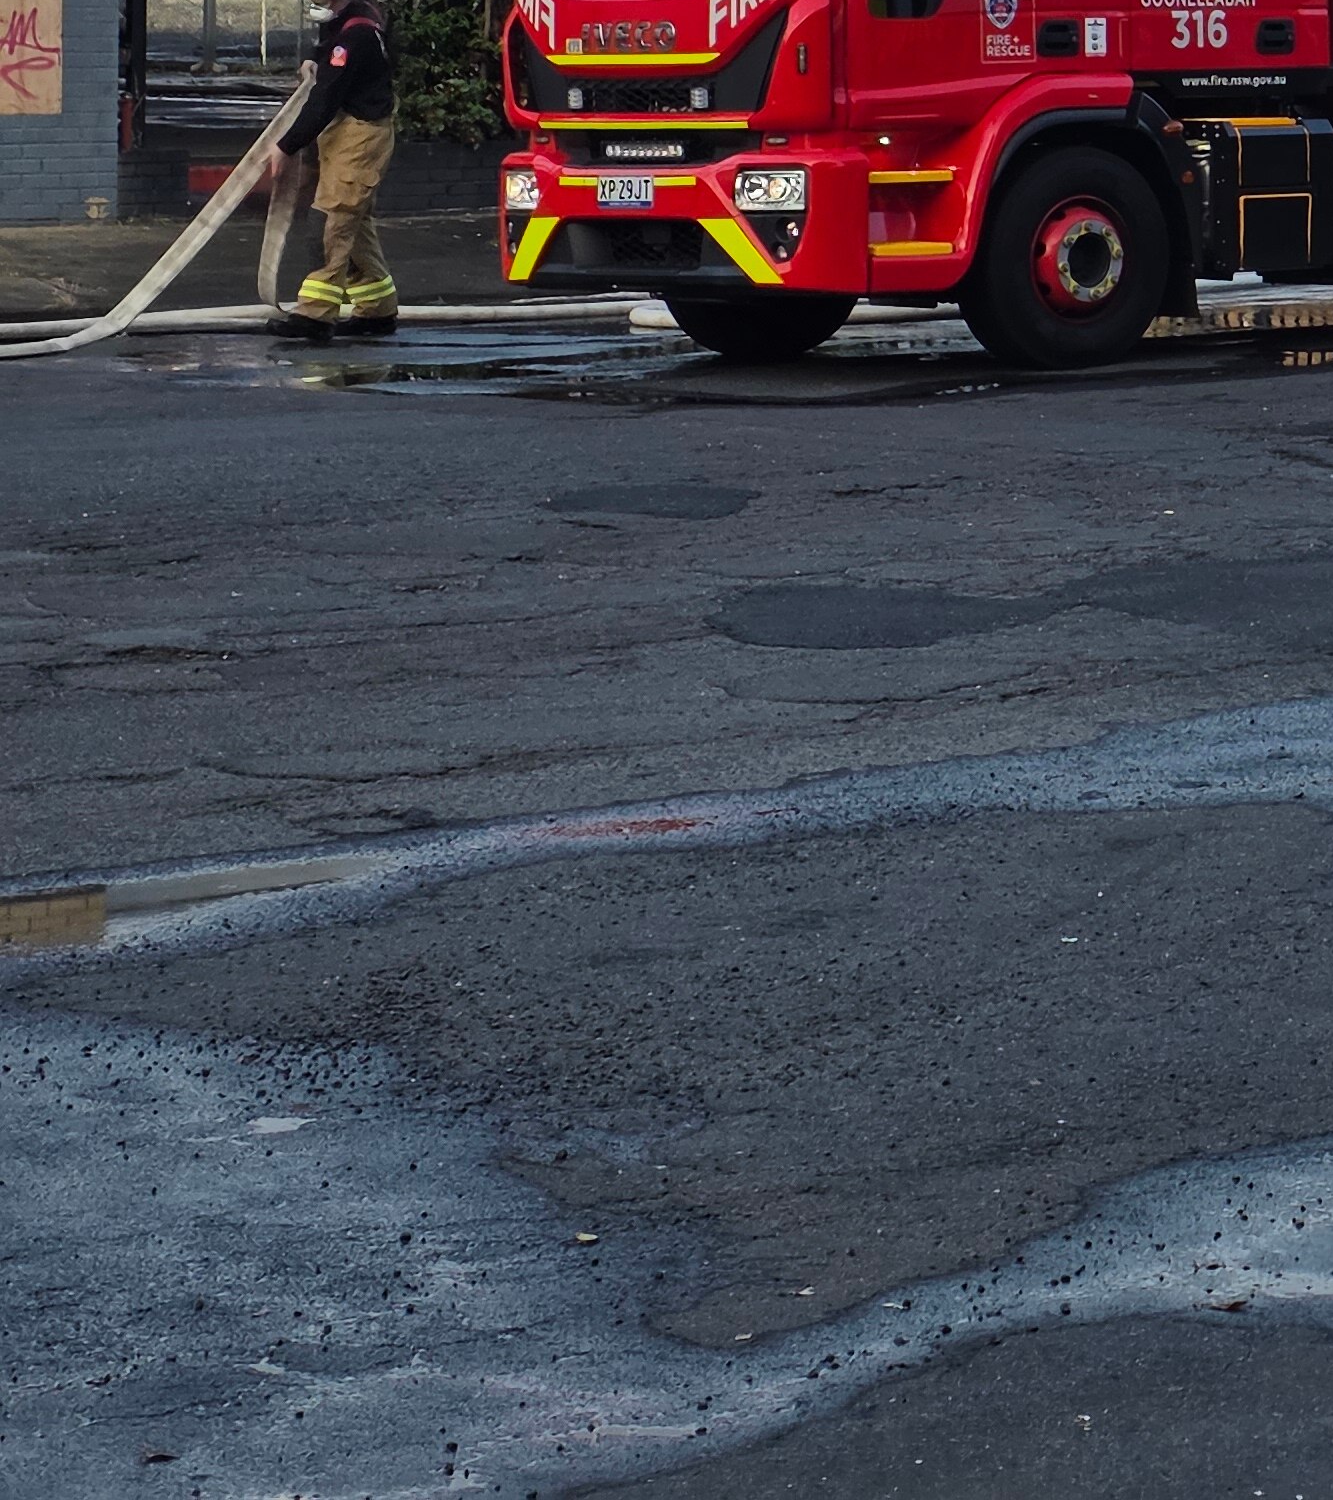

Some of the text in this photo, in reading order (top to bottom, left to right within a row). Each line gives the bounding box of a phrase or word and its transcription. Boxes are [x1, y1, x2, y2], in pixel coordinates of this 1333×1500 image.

[581, 20, 676, 52] IVECO
[1170, 9, 1228, 49] 316
[986, 34, 1011, 46] FIRE
[986, 45, 1031, 57] RESCUE
[1181, 74, 1287, 88] www.fire.nsw.gov.au
